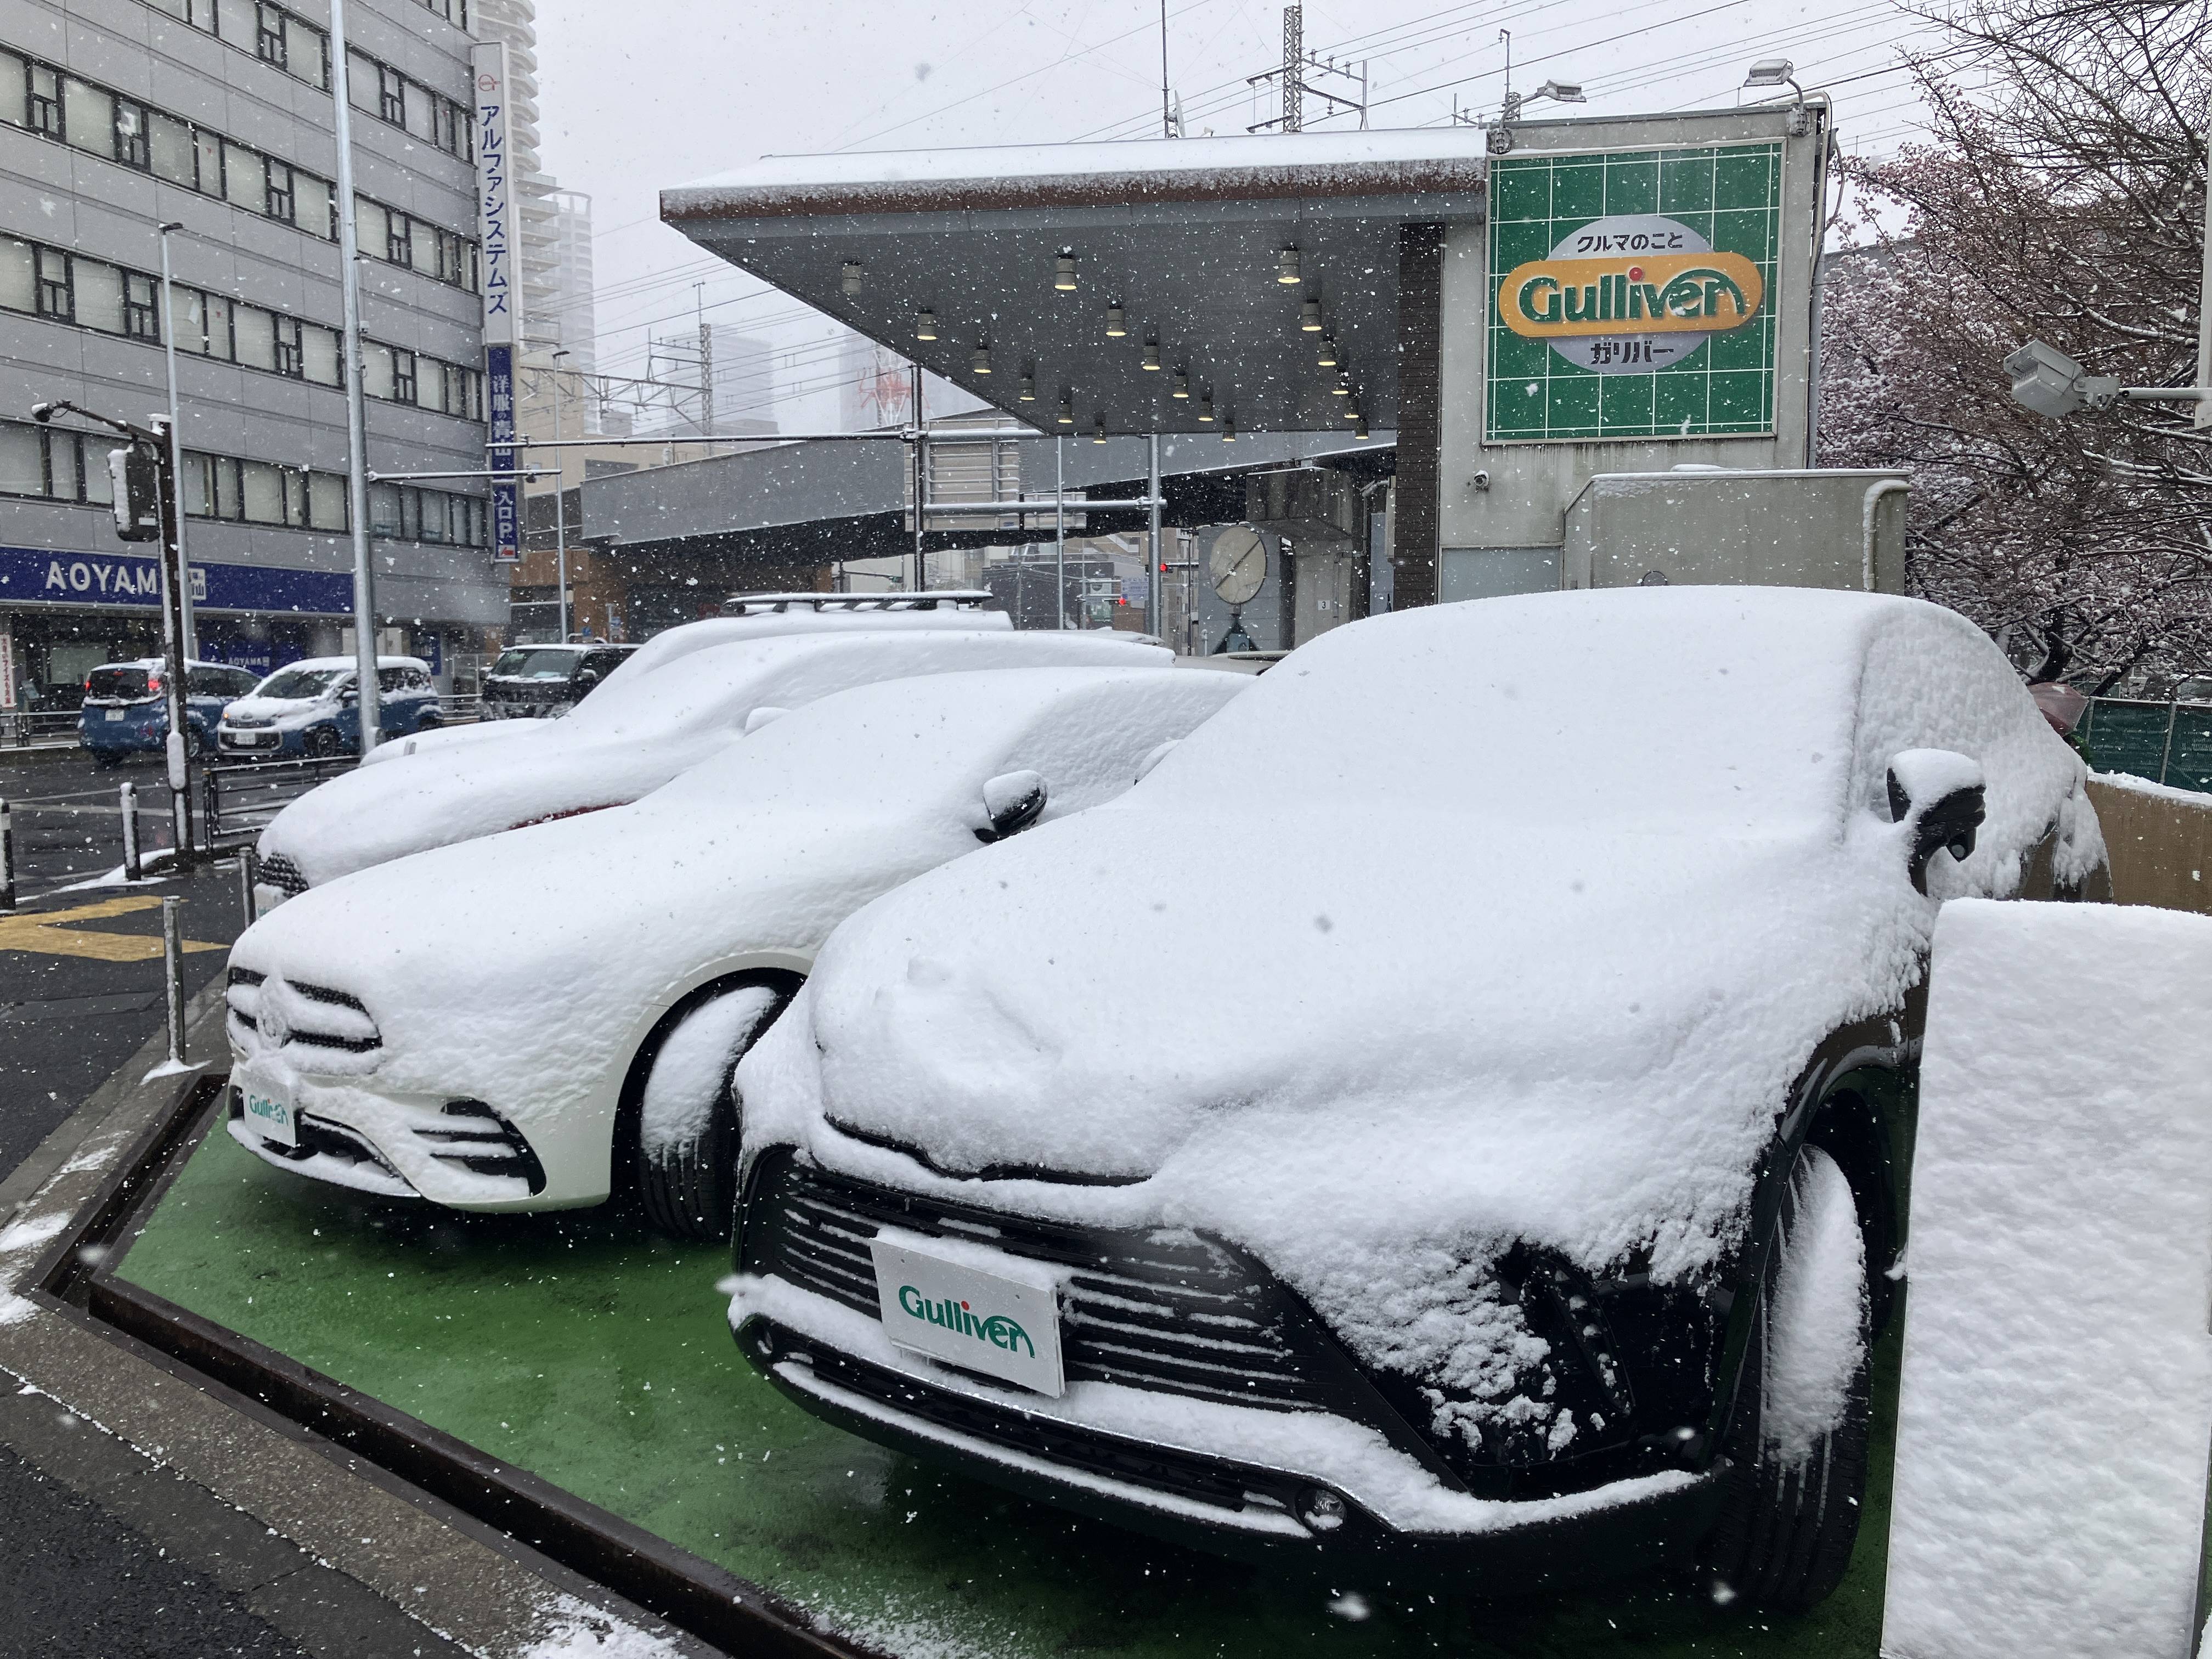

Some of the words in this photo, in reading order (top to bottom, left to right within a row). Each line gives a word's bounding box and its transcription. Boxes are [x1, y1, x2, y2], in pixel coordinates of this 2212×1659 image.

[481, 105, 508, 314] アルファシステムズ
[1577, 232, 1683, 253] クルマのこと
[1518, 266, 1746, 324] Gulliver
[1590, 340, 1674, 365] ガリバー
[492, 374, 513, 457] 洋服の青山
[45, 561, 159, 595] AOYAM
[1322, 601, 1326, 609] 3
[898, 1285, 1036, 1359] Gulliver
